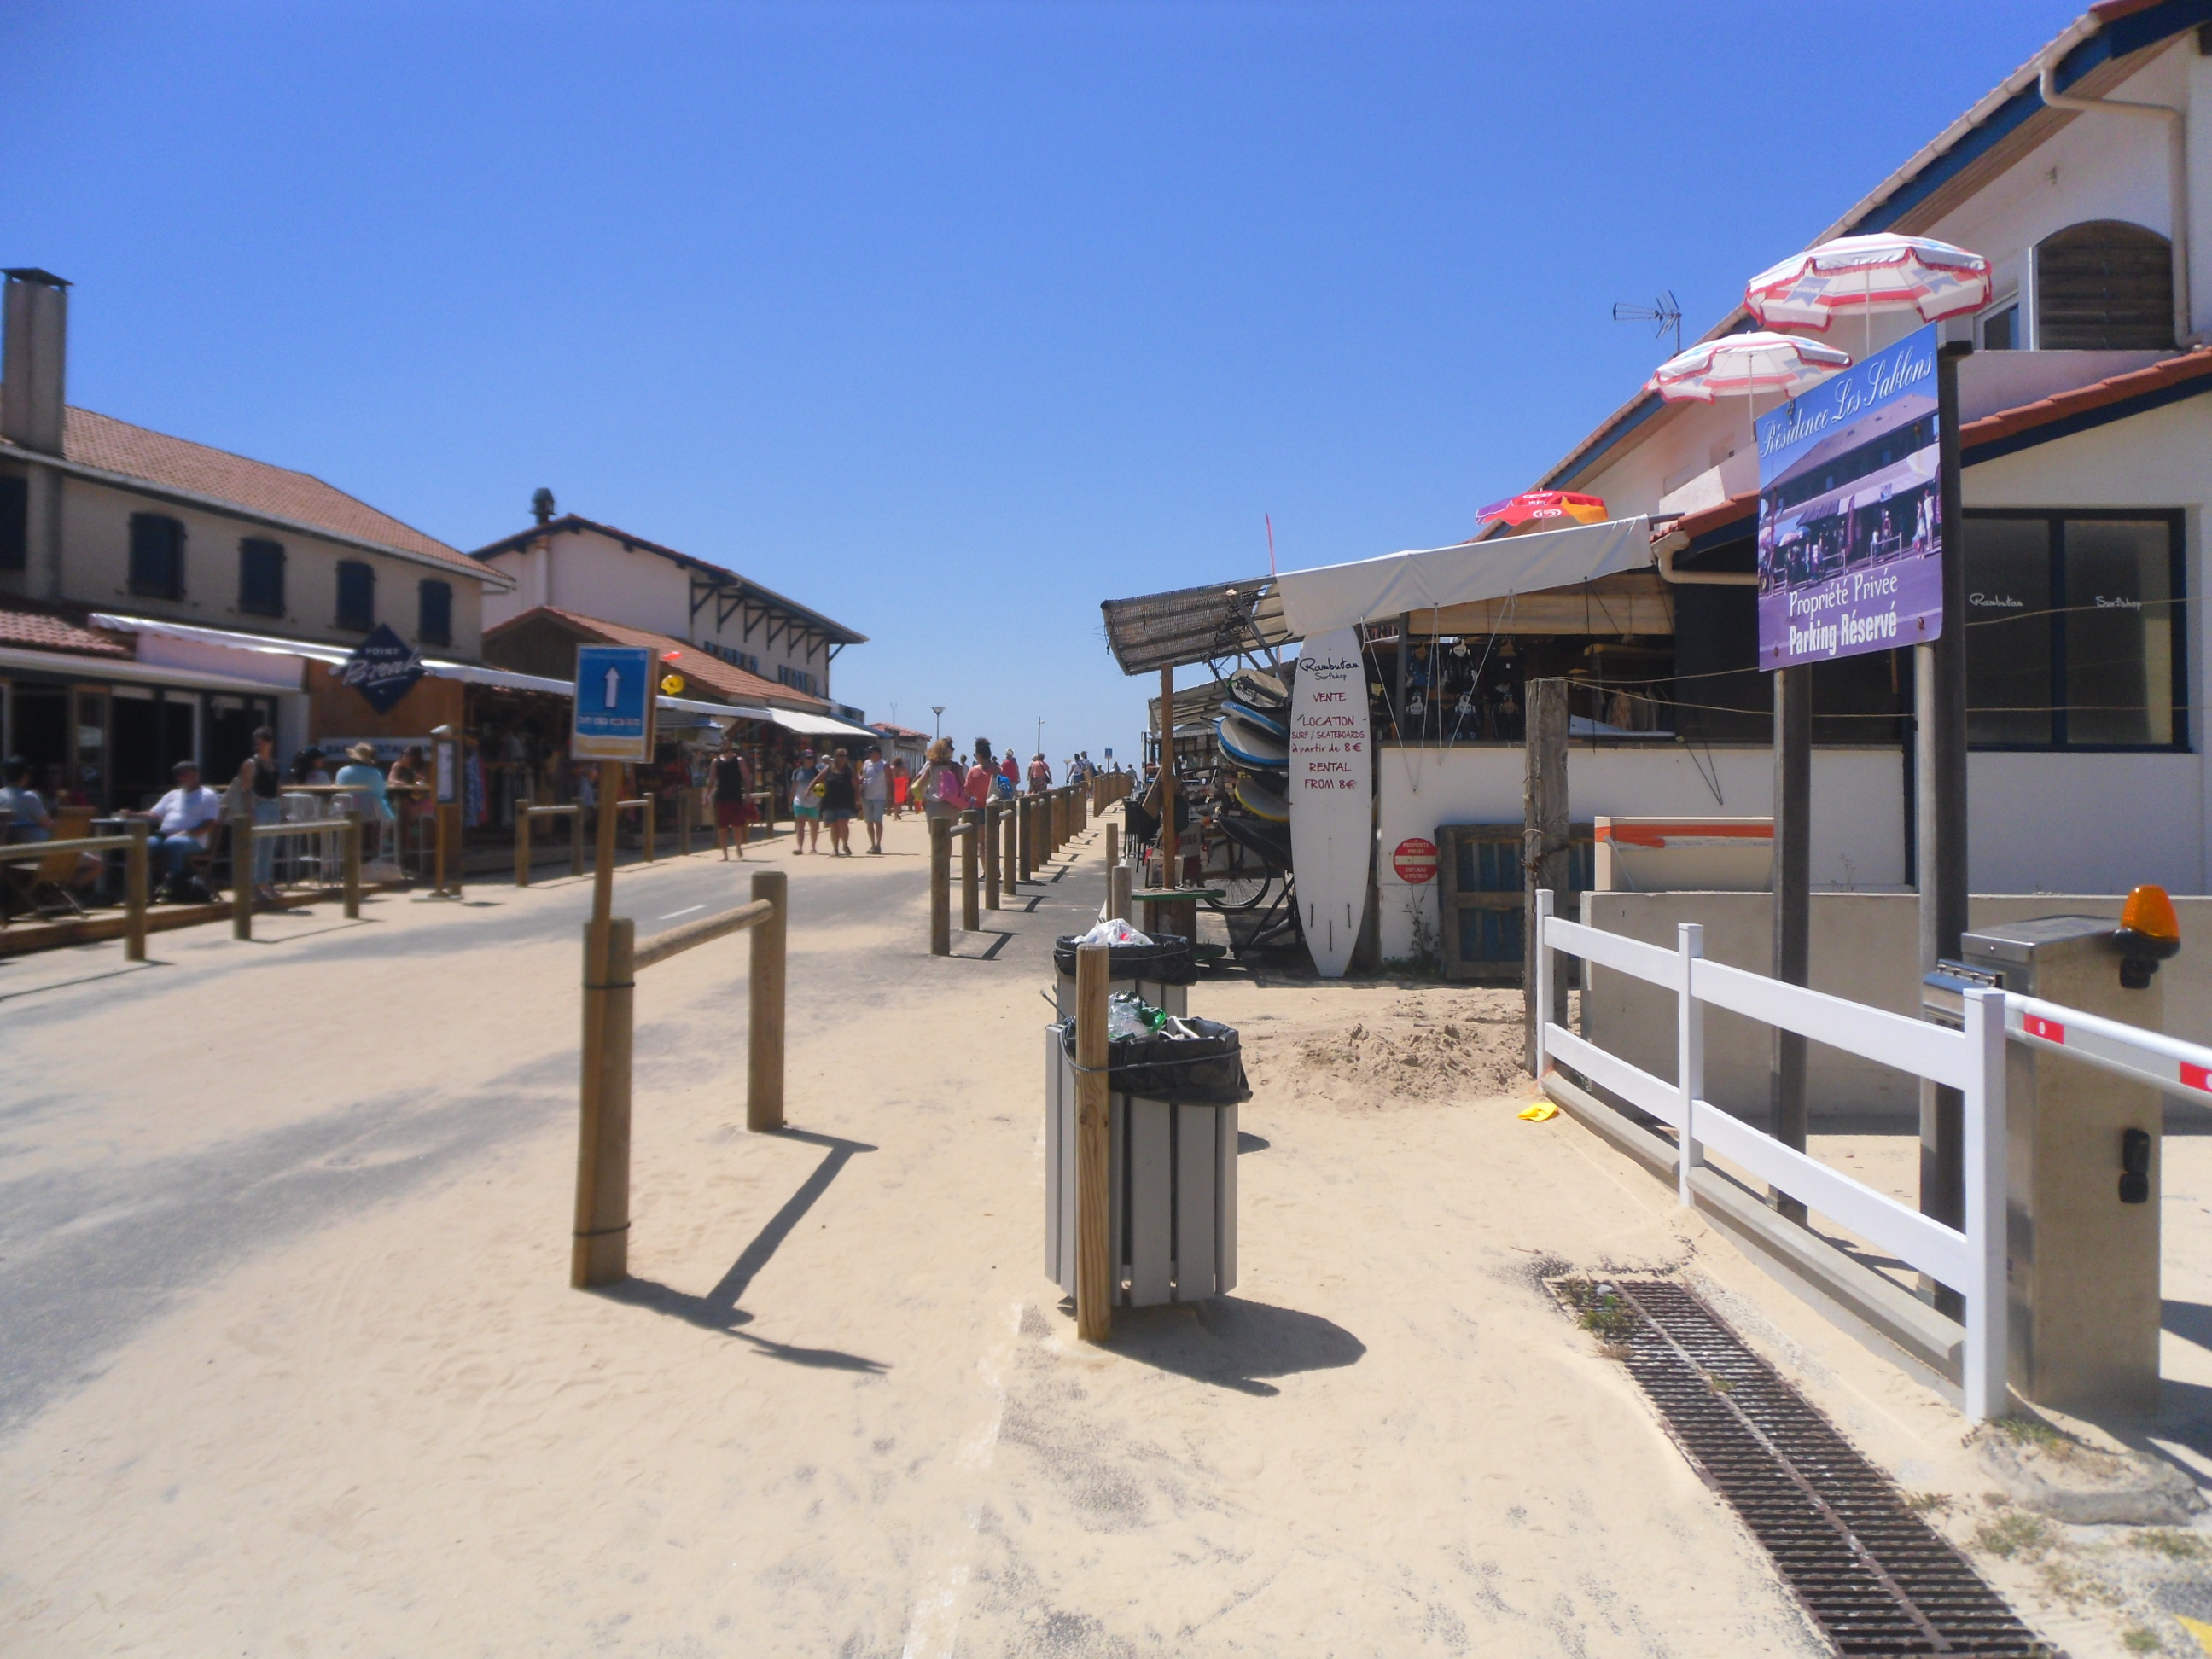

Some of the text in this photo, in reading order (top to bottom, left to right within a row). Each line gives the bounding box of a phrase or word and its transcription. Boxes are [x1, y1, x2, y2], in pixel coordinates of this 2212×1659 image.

[1760, 345, 1933, 458] Résidence Les Sablons
[1790, 568, 1898, 618] Propriété Privée
[1790, 600, 1897, 656] Parking Réservé
[365, 647, 399, 655] POINT
[1299, 656, 1359, 672] Rambutan
[1315, 672, 1347, 681] Surfshop
[1313, 692, 1347, 702] VENTE
[1302, 715, 1355, 726] LOCATION
[1291, 731, 1308, 739] SURF
[1316, 731, 1365, 739] SKATEBOARDS
[1300, 742, 1326, 755] partir
[1329, 742, 1341, 753] de
[1309, 762, 1352, 772] RENTAL
[1304, 778, 1334, 789] FROM
